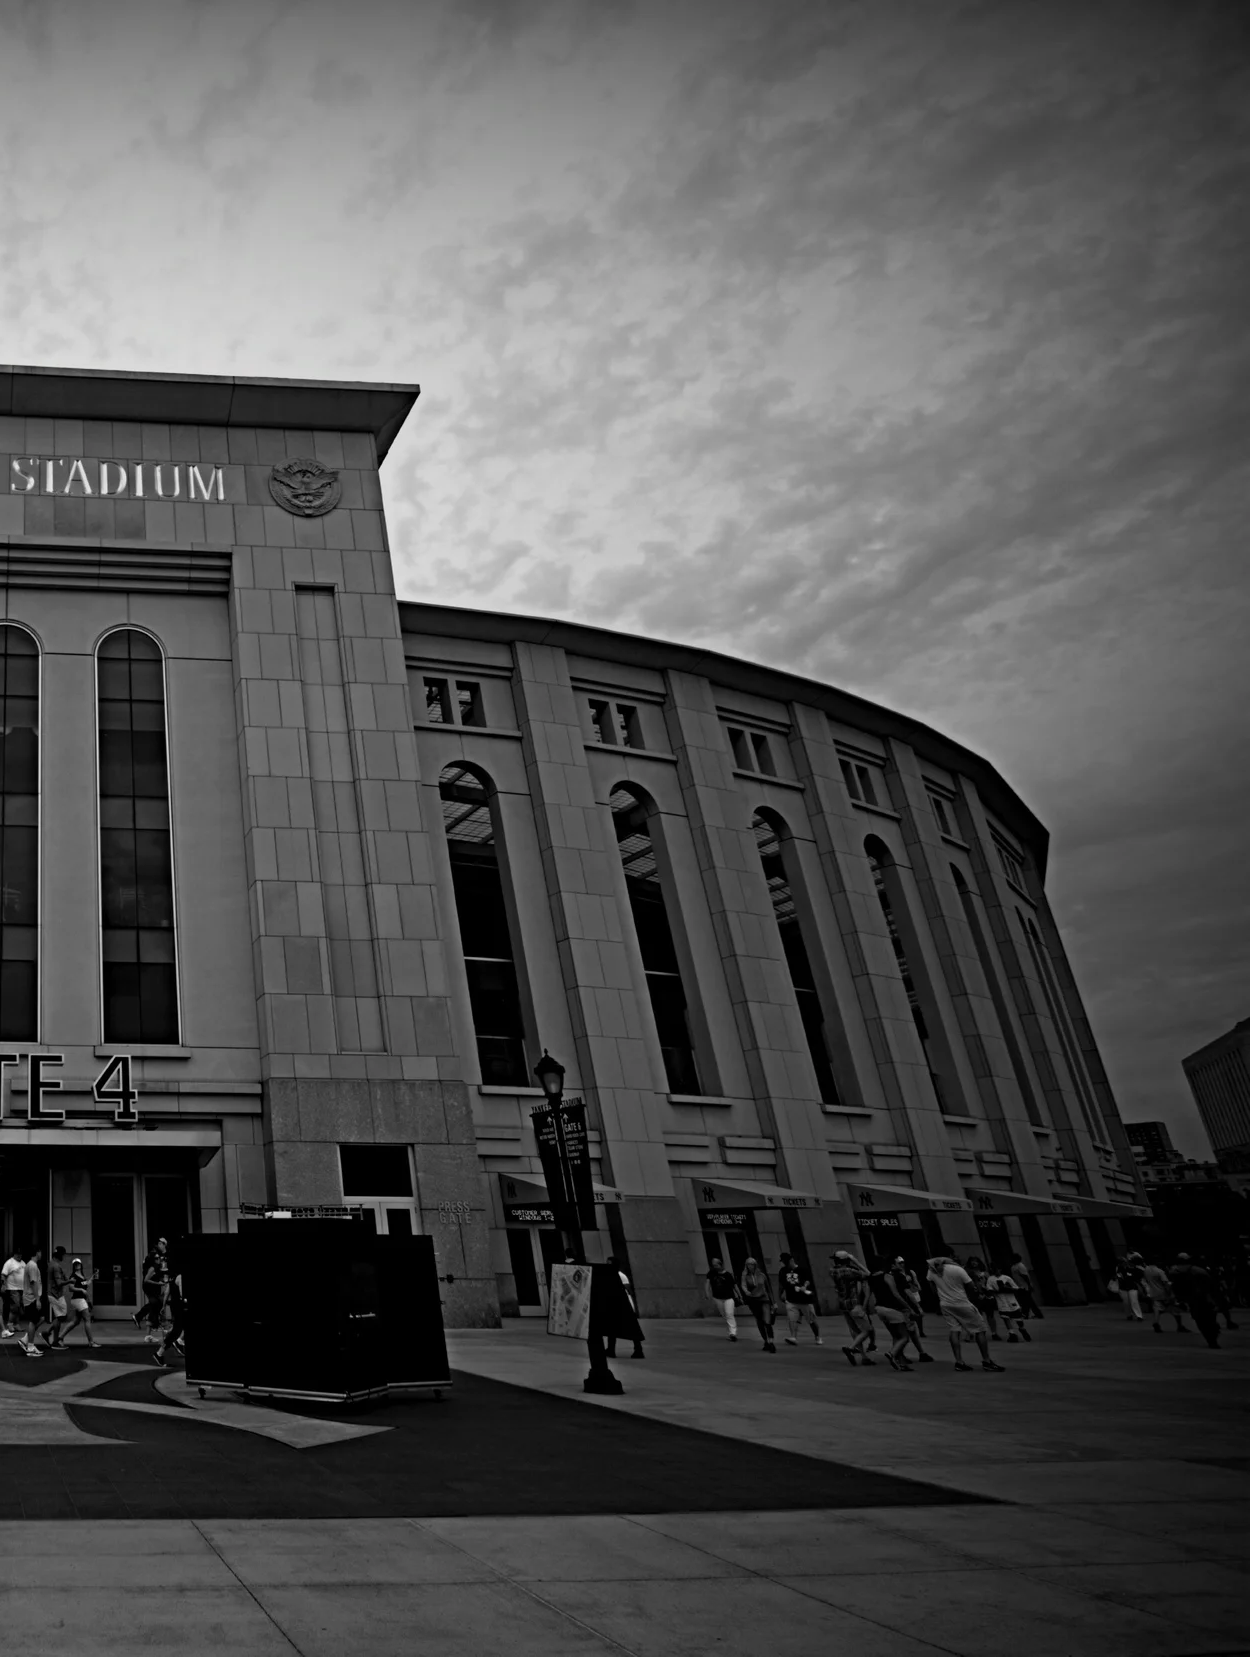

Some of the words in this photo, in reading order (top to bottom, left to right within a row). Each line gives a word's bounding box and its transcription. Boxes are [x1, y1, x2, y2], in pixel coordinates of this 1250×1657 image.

[11, 457, 226, 500] STADIUM
[92, 1054, 139, 1123] 4
[564, 1123, 577, 1132] GATE
[438, 1200, 470, 1212] PRESS
[782, 1197, 807, 1206] TICKETS
[439, 1212, 472, 1224] GATE
[857, 1218, 878, 1226] TICKET
[880, 1218, 898, 1226] SALES
